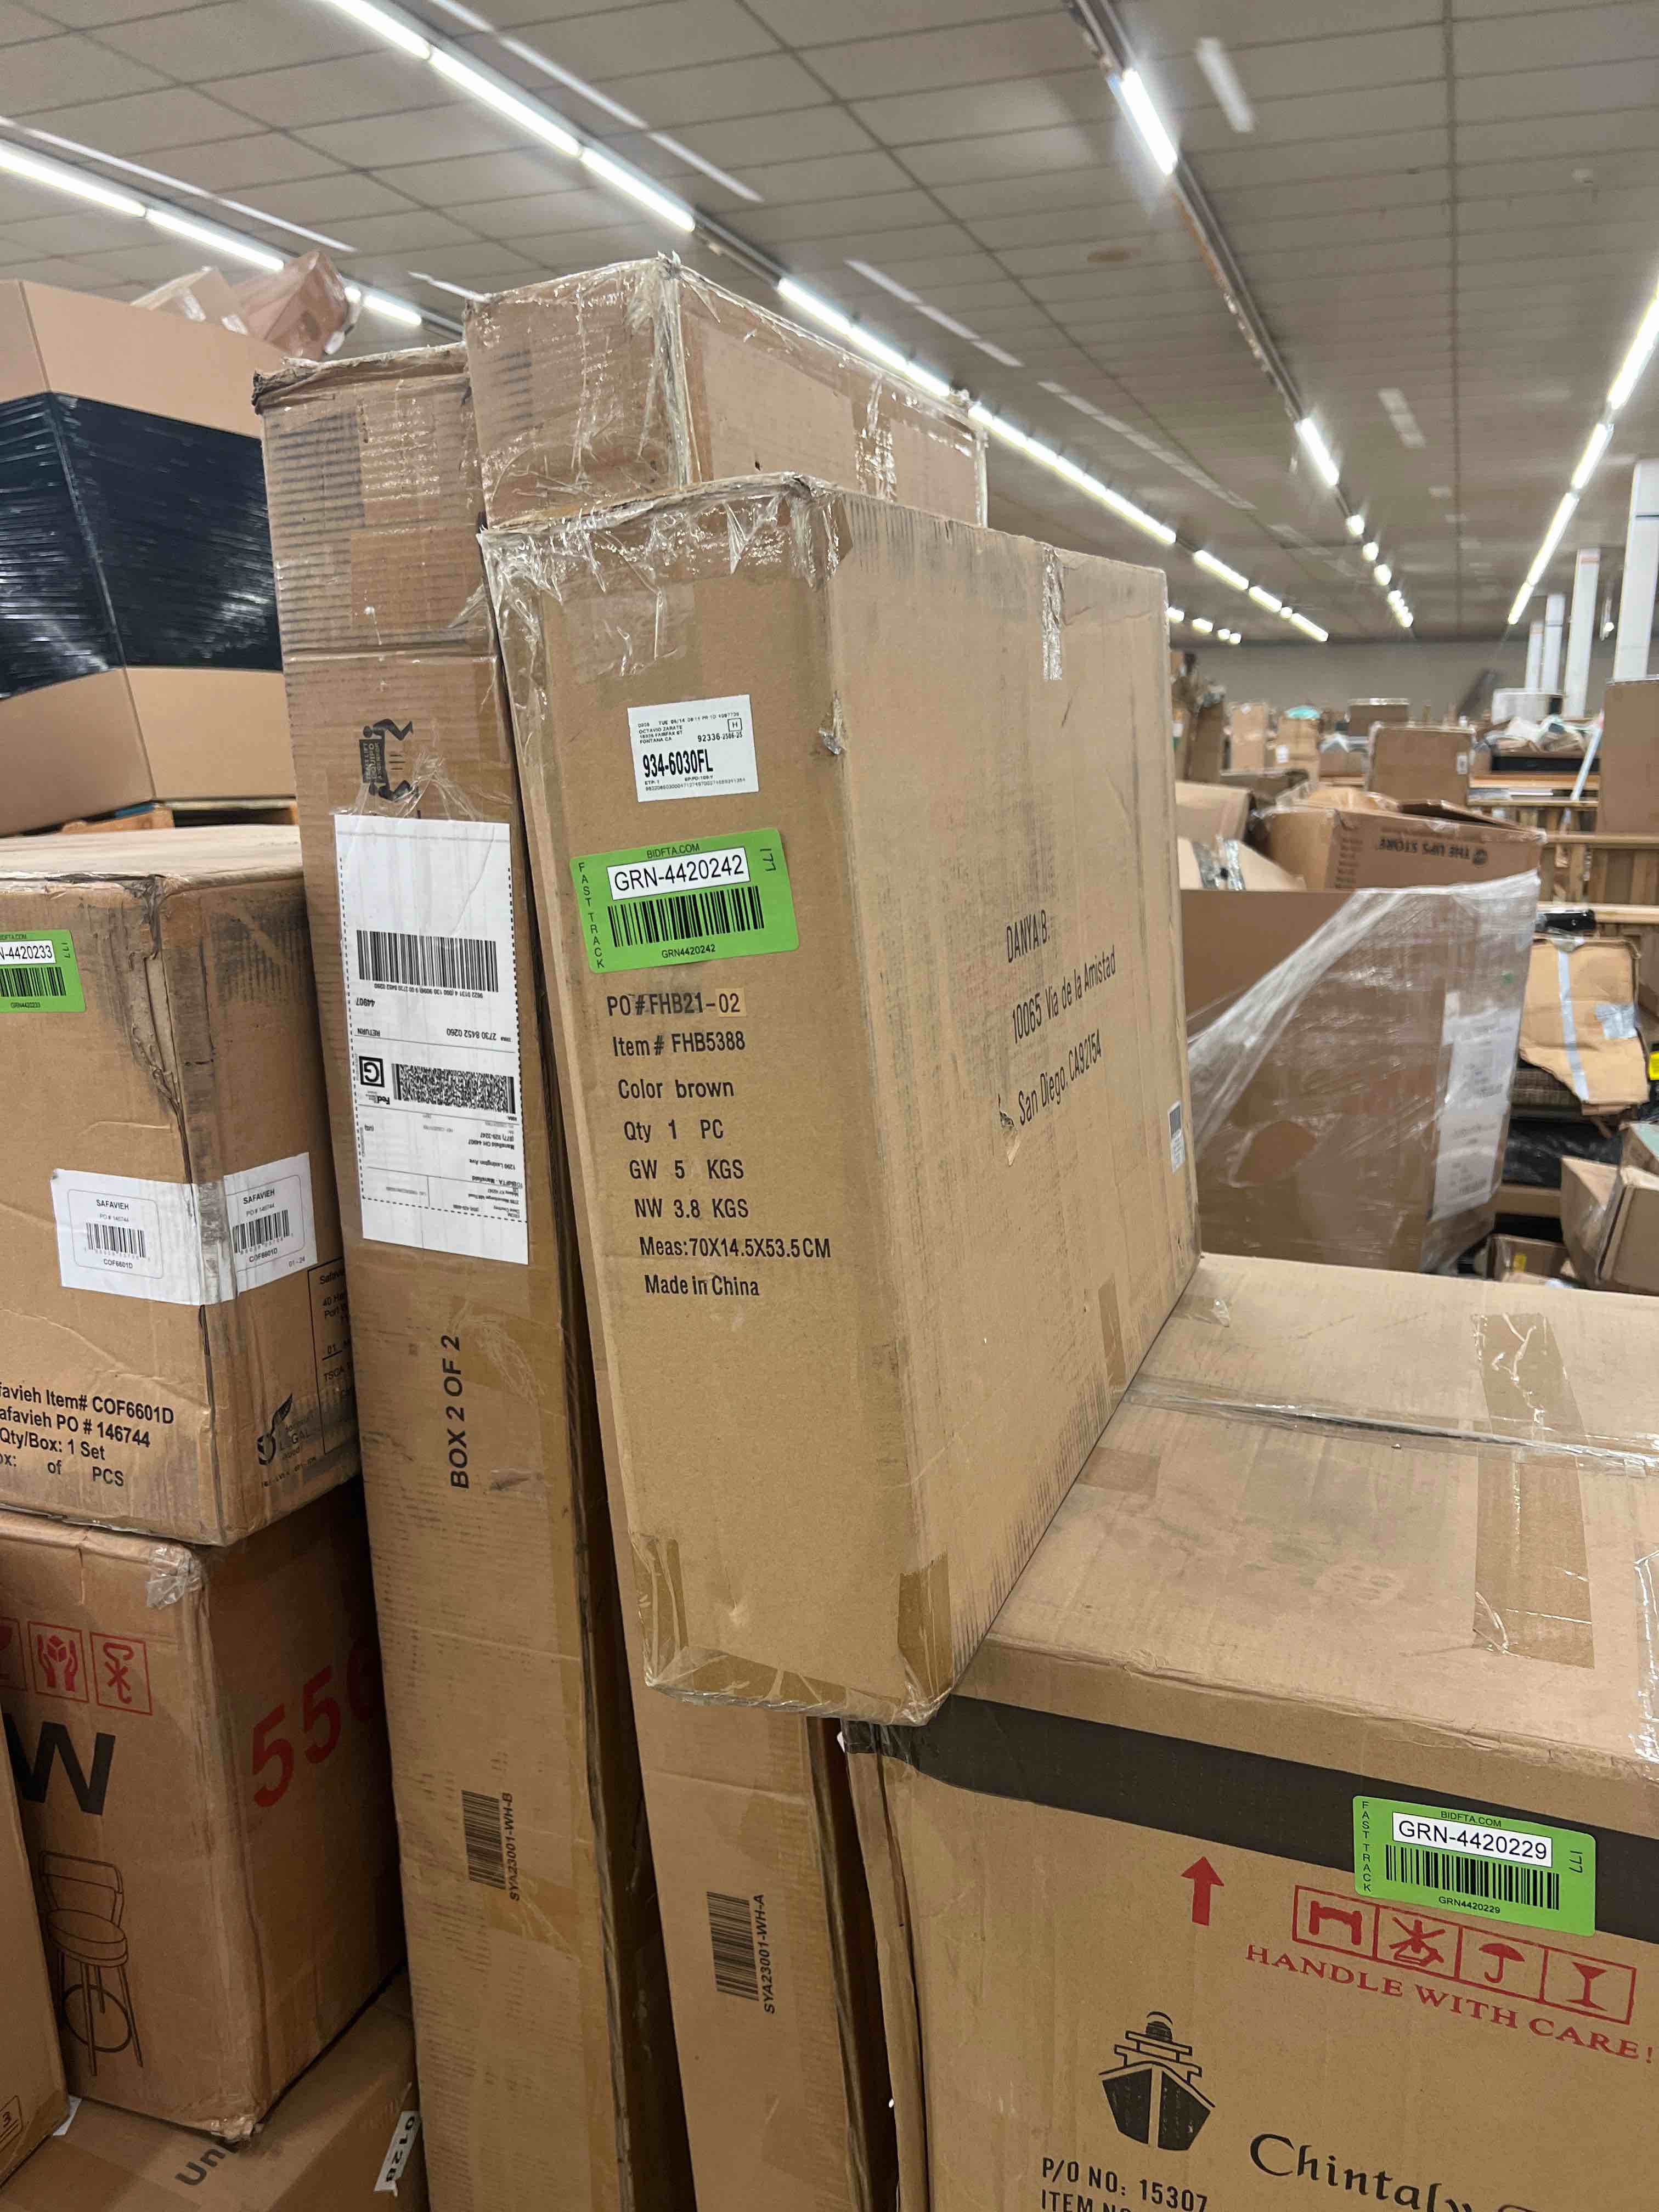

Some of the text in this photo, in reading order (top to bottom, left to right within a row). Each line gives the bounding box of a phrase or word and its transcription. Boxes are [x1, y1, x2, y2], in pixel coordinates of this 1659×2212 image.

[368, 743, 377, 780] EQUIPO
[643, 748, 713, 778] 934-6030FL
[647, 843, 700, 859] BIDFTA.COM
[1378, 839, 1418, 853] STORE
[1422, 843, 1445, 857] UPS
[1449, 847, 1470, 860] THE
[614, 855, 744, 891] GRN-4420242
[1006, 913, 1039, 963] DANYA
[661, 944, 716, 958] GRN4420242
[356, 997, 375, 1008] 44907
[1012, 944, 1116, 1044] 10065 Via de la Amistad
[357, 1028, 381, 1037] RETURN
[447, 1029, 462, 1037] 0260
[464, 1029, 480, 1039] 8452
[481, 1031, 496, 1040] 2730
[671, 1031, 746, 1053] FHB5388
[364, 1062, 380, 1083] G
[1019, 1088, 1038, 1125] San
[1068, 1028, 1102, 1082] CA92154
[618, 1079, 735, 1099] Color brown
[624, 1119, 724, 1143] Qty 1 PC
[629, 1159, 744, 1179] GW 5 KGS
[96, 1199, 129, 1210] SAFAVIEH
[243, 1189, 275, 1204] SAFAVIEH
[634, 1198, 749, 1218] NW 3.8 KGS
[103, 1259, 133, 1268] COF6601D
[249, 1248, 278, 1262] COF6601D
[645, 1274, 759, 1296] Made in China
[46, 1389, 88, 1410] Item#
[93, 1396, 174, 1424] COF6601D
[441, 1335, 470, 1489] BOX 2 OF 2
[57, 1414, 78, 1432] PO
[83, 1419, 92, 1435] #
[97, 1421, 151, 1448] 146744
[0, 1427, 105, 1460] Qty/Box: 1 Set
[48, 1460, 62, 1475] of
[92, 1466, 124, 1487] PCS
[1440, 1811, 1502, 1827] BIDFTA.COM
[501, 1792, 520, 1901] SYA23001-WH-B
[1398, 1820, 1548, 1860] GRN-4420229
[1438, 1895, 1501, 1914] GRN4420229
[753, 1894, 775, 2015] SYA23001-WH-A
[1245, 1944, 1403, 1997] HANDLE
[1414, 1983, 1518, 2029] WITH
[1043, 2157, 1080, 2182] P/O
[1139, 2179, 1207, 2212] 15307
[1042, 2189, 1093, 2212] ITEM
